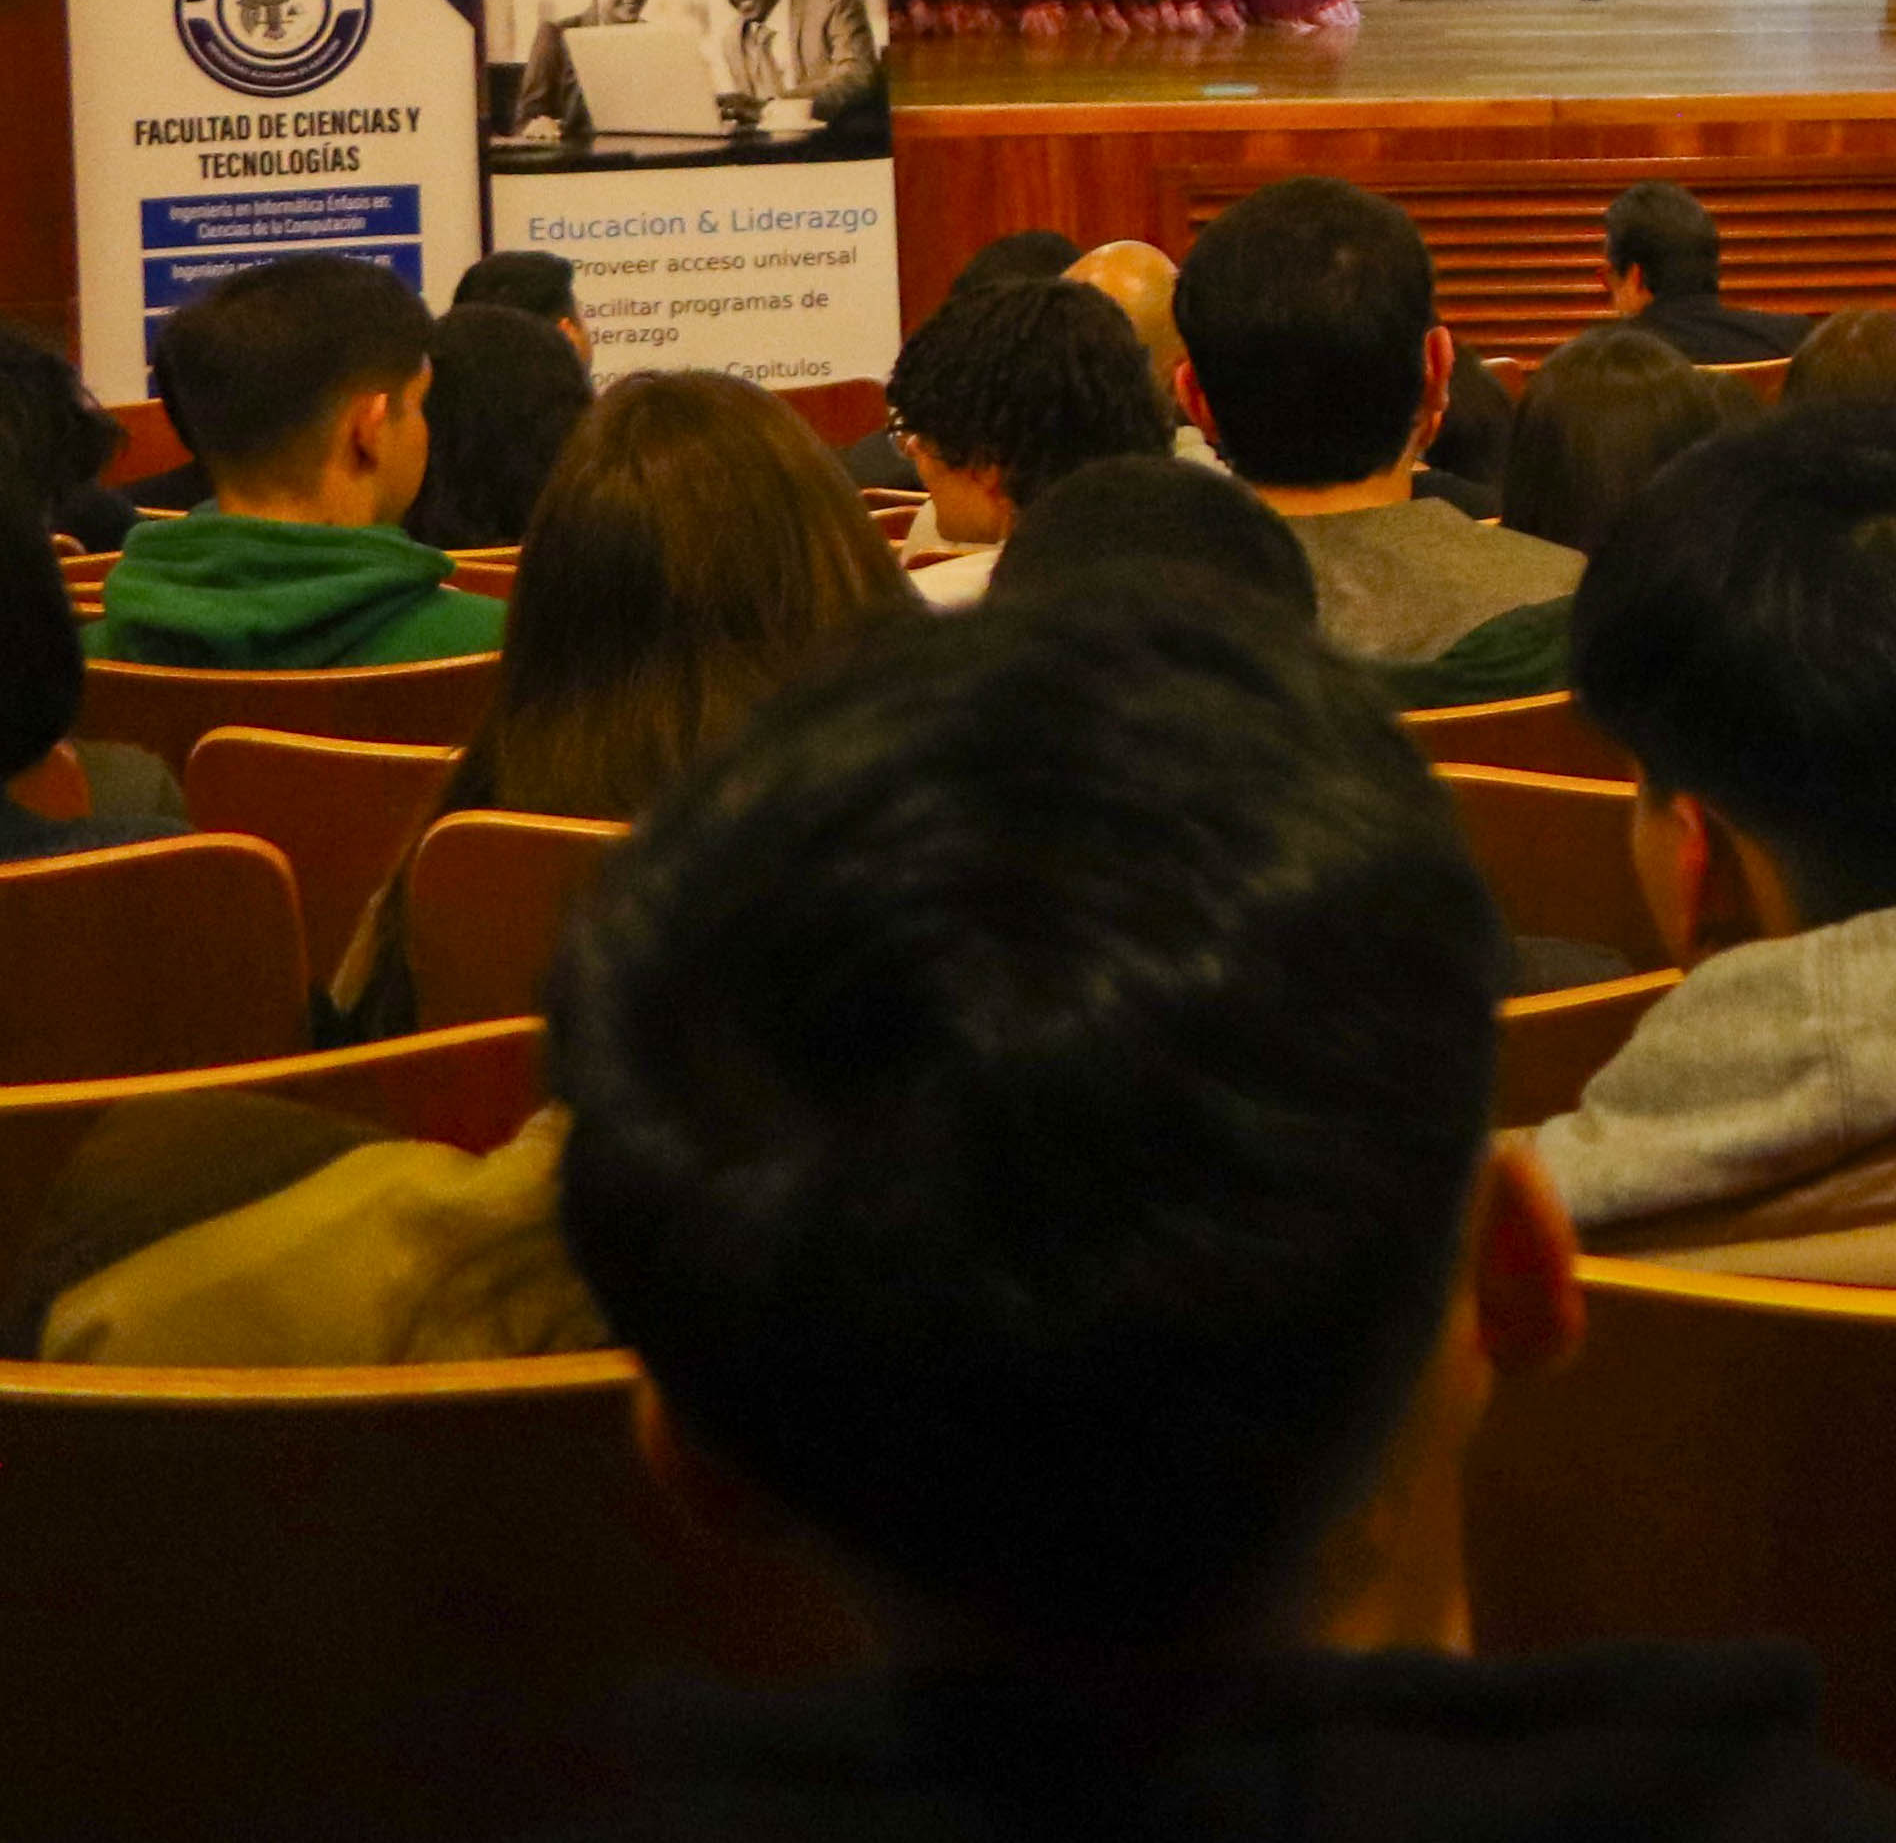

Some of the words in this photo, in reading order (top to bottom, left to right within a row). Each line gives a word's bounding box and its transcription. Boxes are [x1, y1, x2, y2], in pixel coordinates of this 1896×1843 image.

[134, 113, 252, 146] FACULTAD
[258, 112, 288, 140] DE
[293, 107, 401, 138] CIENCIAS
[405, 106, 421, 133] Y
[198, 142, 361, 180] TECNOLOGÍAS
[528, 213, 687, 242] Educacion
[696, 209, 719, 235] &
[730, 205, 879, 235] Liderazgo
[573, 258, 659, 277] Proveer
[667, 255, 746, 273] acceso
[753, 245, 858, 270] universal
[582, 298, 663, 319] acilitar
[669, 291, 794, 320] programas
[800, 289, 831, 308] de
